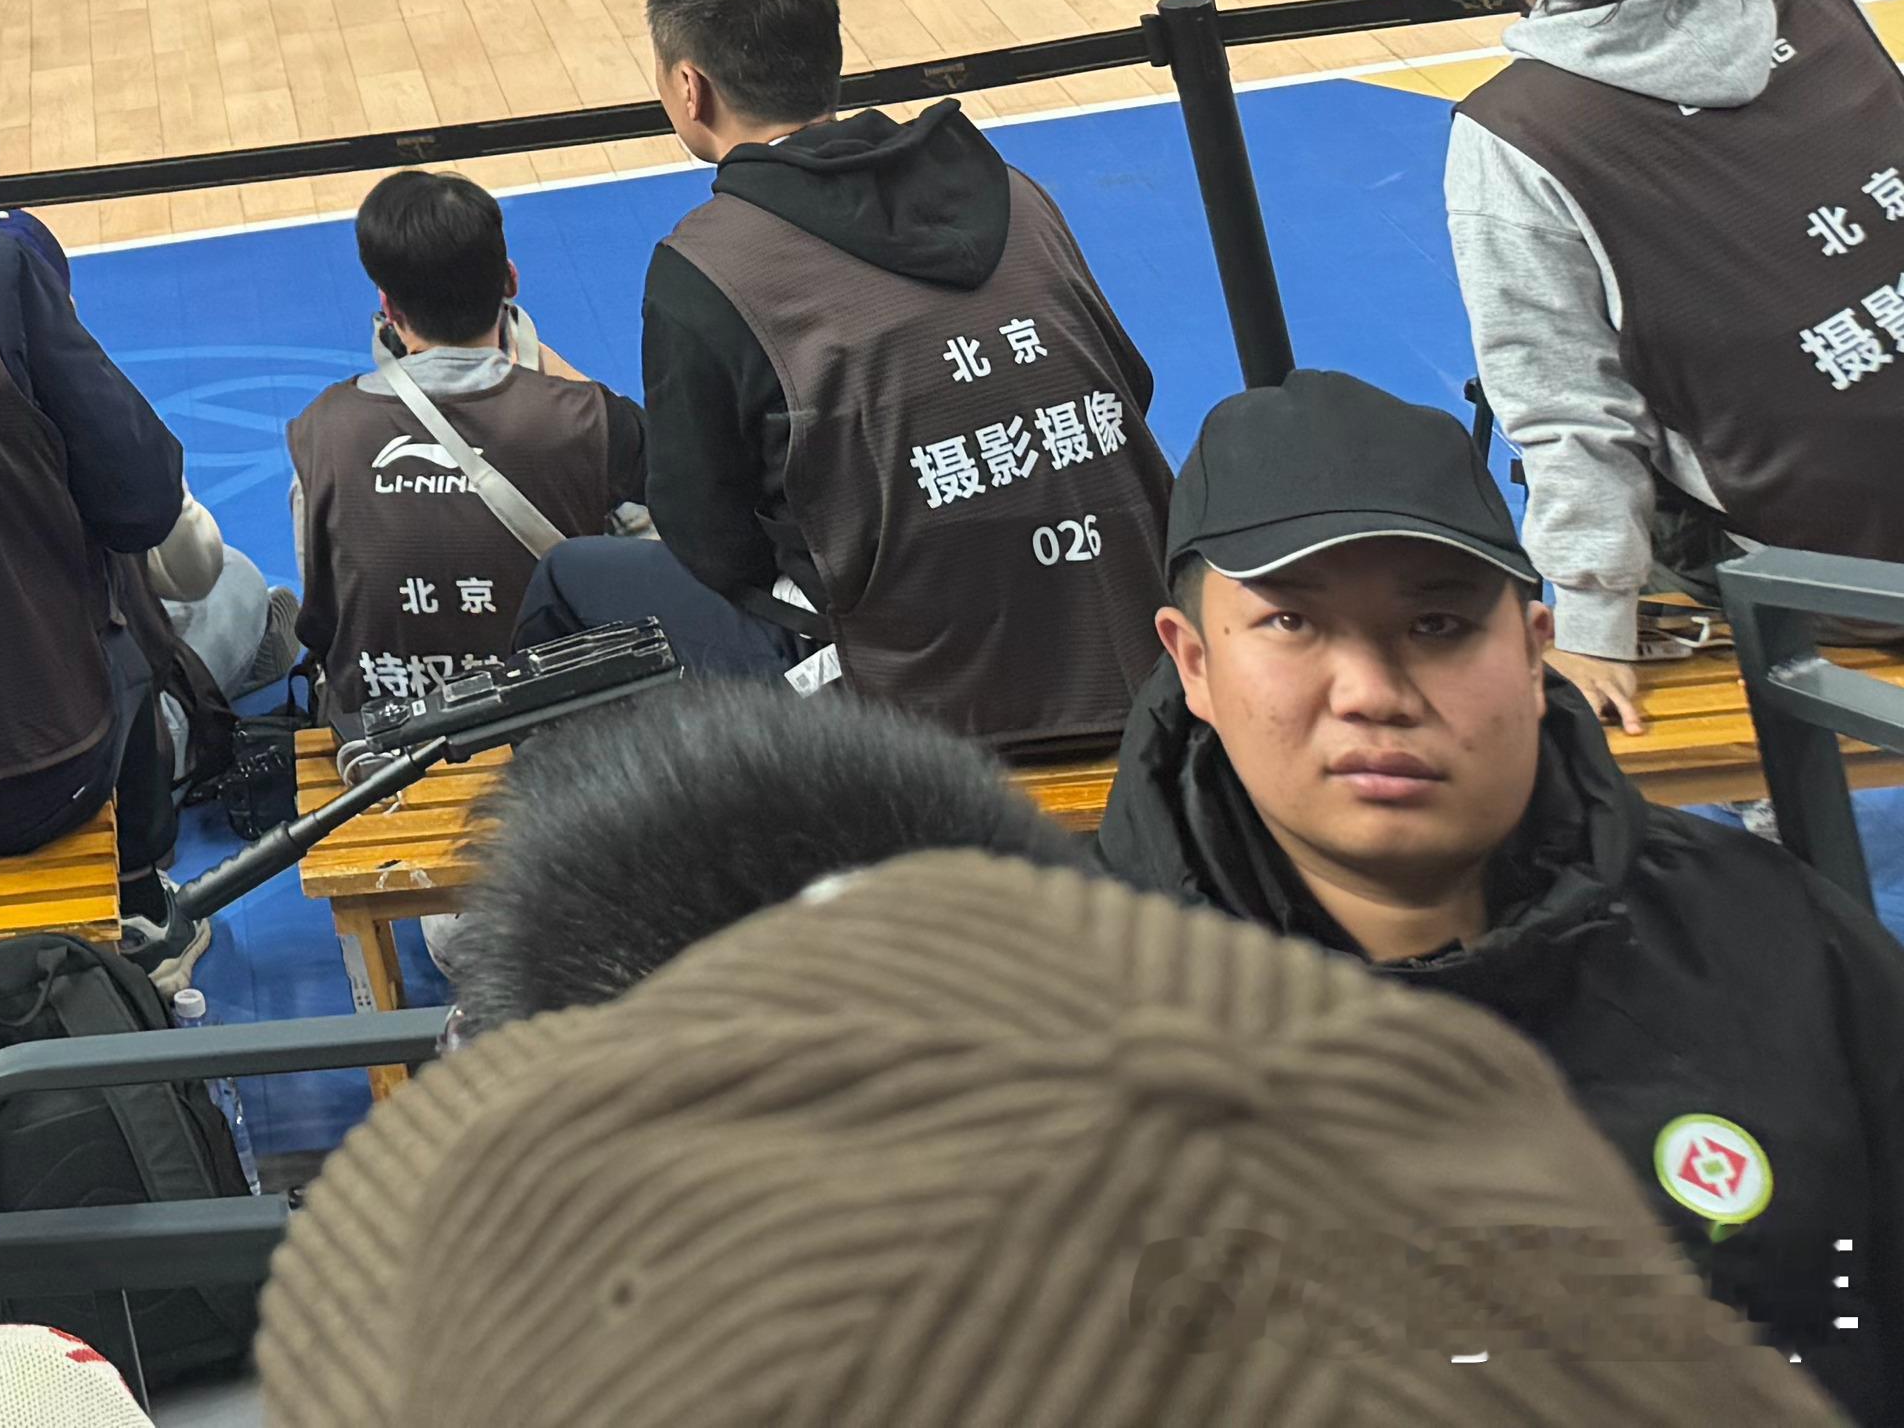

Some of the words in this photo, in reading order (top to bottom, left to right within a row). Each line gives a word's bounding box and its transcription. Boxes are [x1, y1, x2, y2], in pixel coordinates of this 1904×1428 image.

[942, 315, 1048, 384] 北京
[909, 388, 1130, 511] 摄影摄像
[375, 472, 481, 495] LI-NIN
[1030, 512, 1102, 570] 026
[398, 576, 497, 616] 北京
